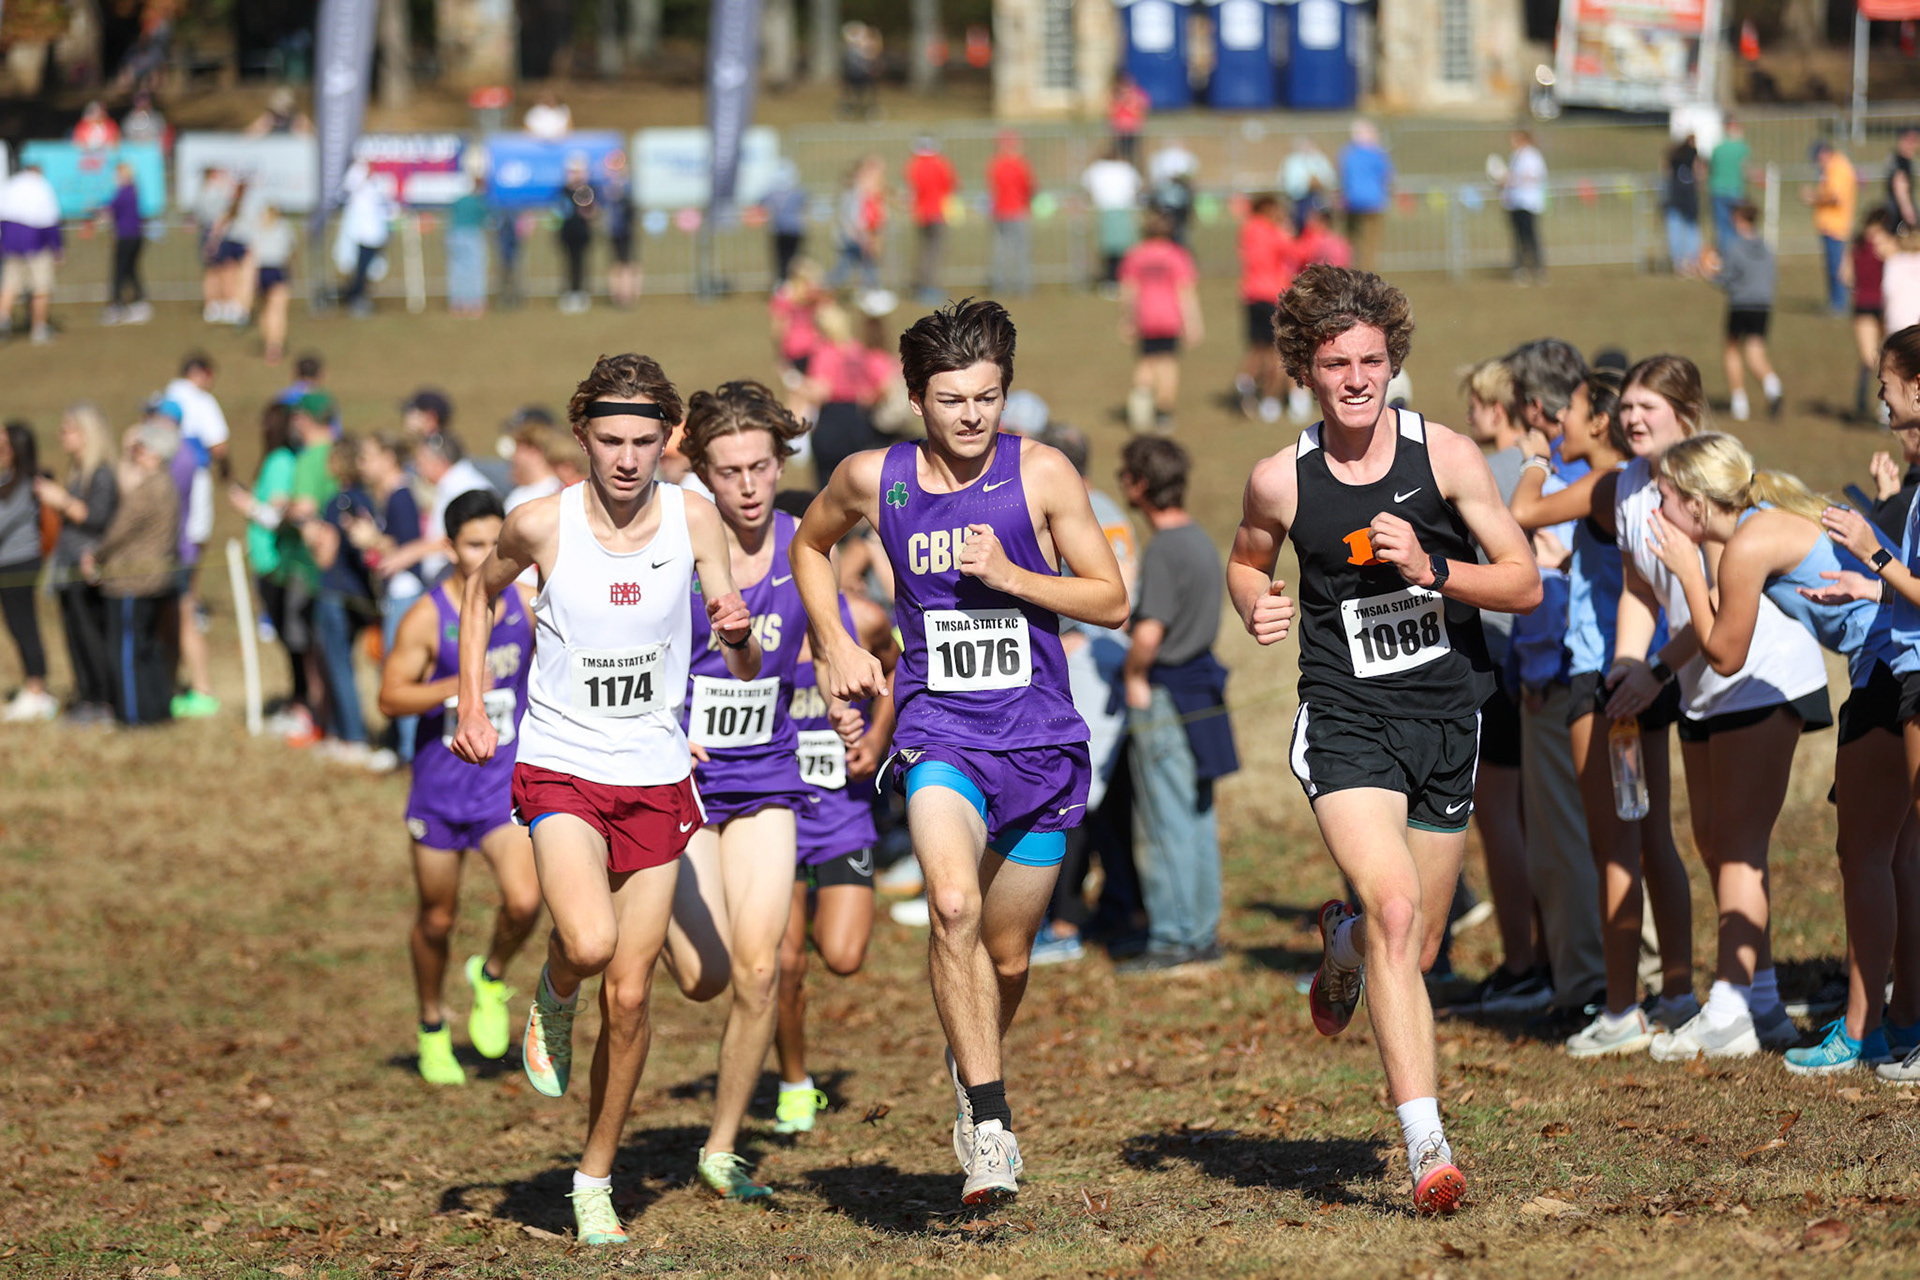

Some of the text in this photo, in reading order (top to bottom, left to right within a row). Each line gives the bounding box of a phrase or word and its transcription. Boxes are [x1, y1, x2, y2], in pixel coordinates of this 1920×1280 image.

[908, 524, 995, 576] CBH
[1353, 591, 1434, 620] TMSAA STATE XC
[935, 617, 1019, 632] TMSAA STATE XC
[1354, 611, 1441, 663] 1088
[582, 652, 657, 668] TMSAA STATE XC
[936, 638, 1020, 679] 1076
[584, 671, 654, 707] 1174
[704, 705, 767, 736] 1071
